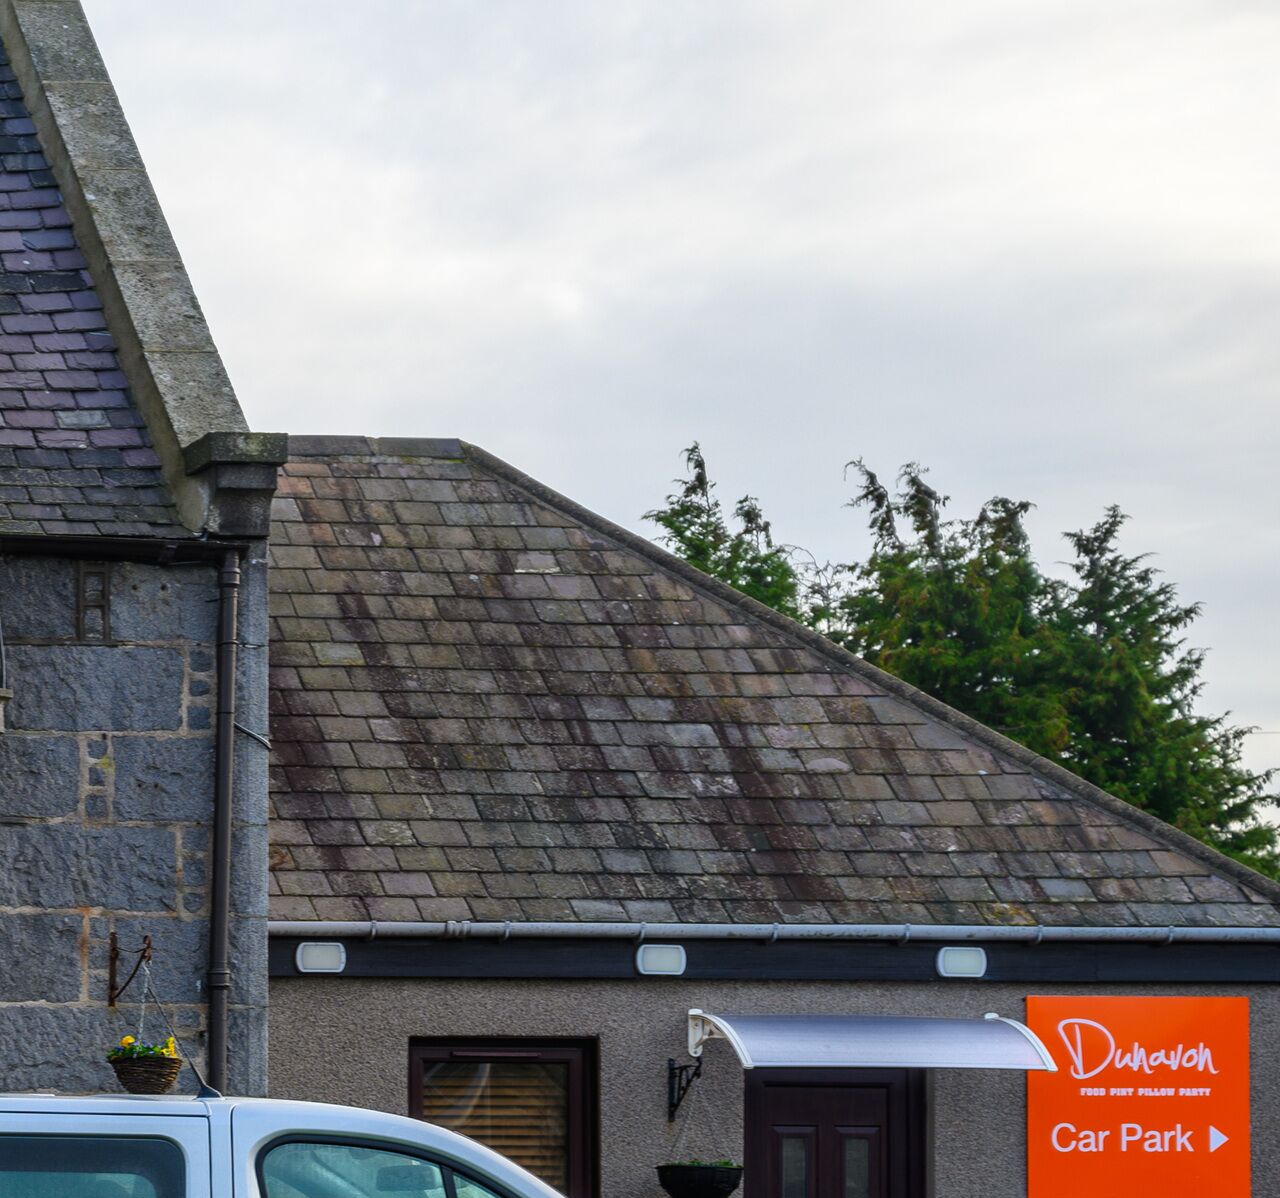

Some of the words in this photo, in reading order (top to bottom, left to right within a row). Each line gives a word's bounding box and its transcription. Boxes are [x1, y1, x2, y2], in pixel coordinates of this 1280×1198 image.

[1057, 1017, 1220, 1080] Dunavon
[1178, 1087, 1212, 1096] PARTY
[1050, 1122, 1110, 1153] Car
[1120, 1123, 1194, 1153] Park
